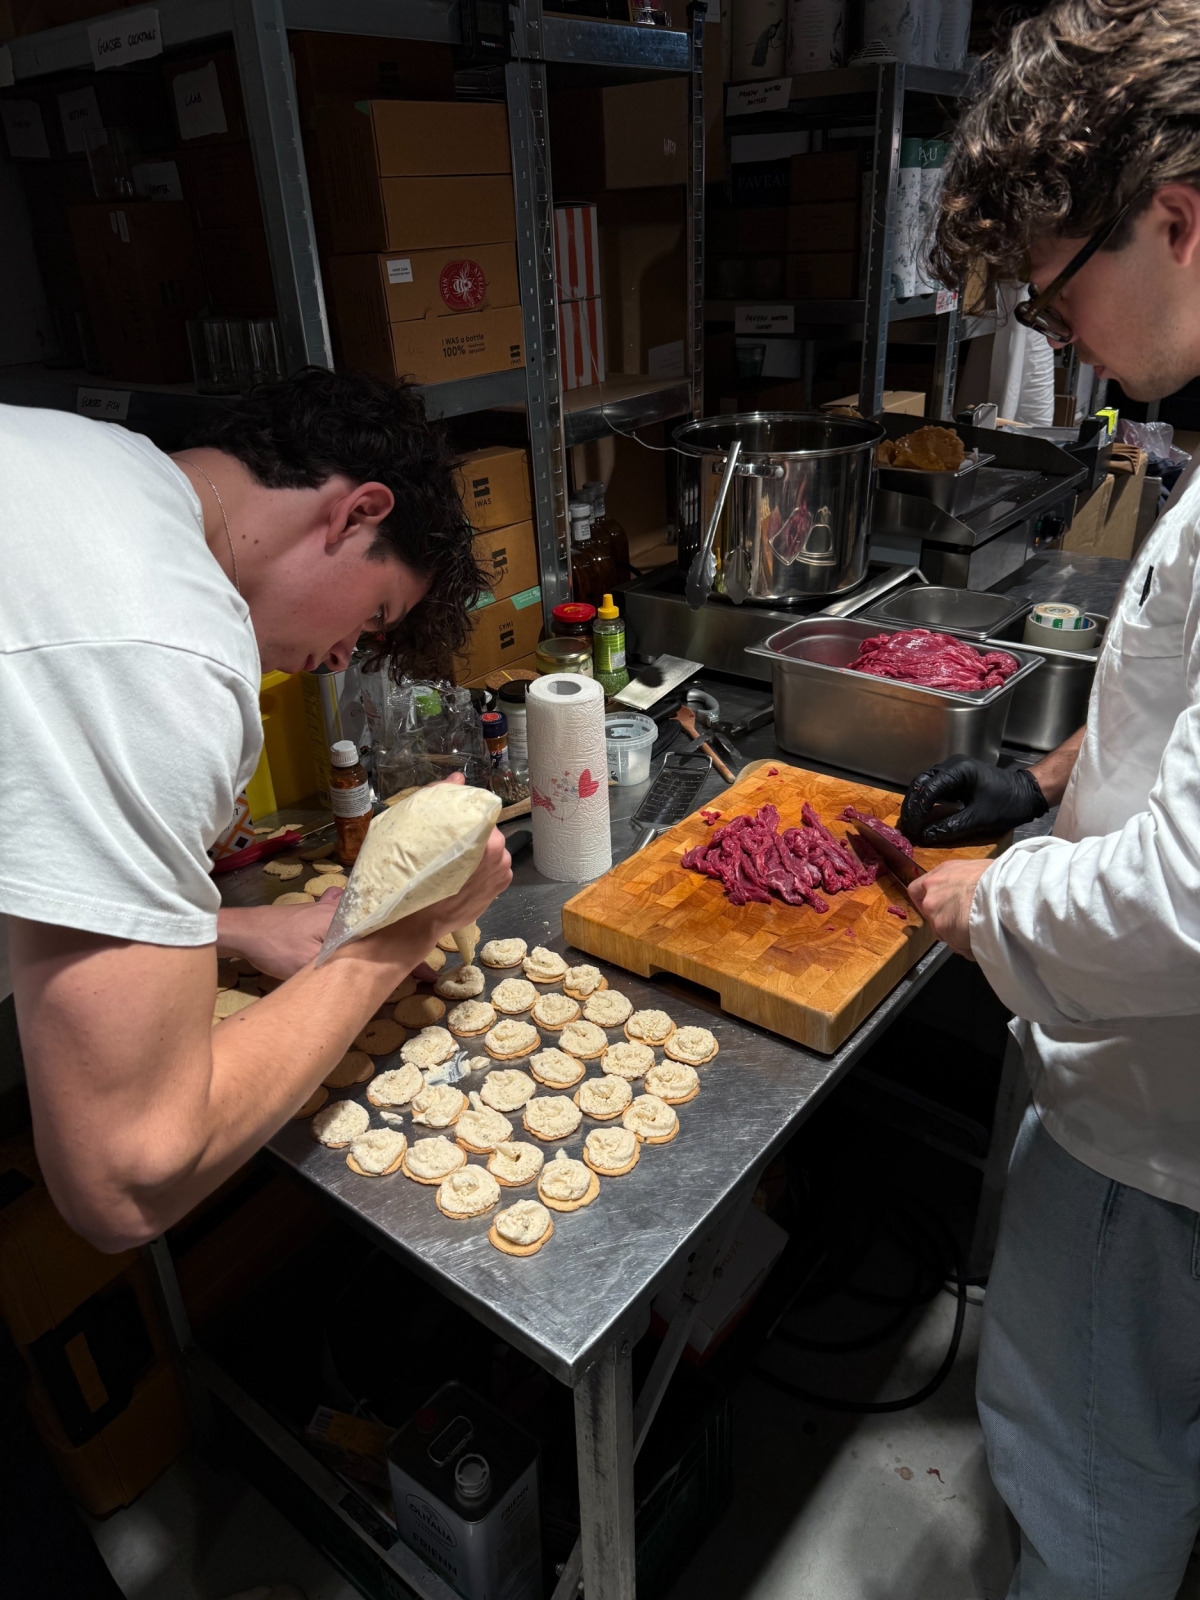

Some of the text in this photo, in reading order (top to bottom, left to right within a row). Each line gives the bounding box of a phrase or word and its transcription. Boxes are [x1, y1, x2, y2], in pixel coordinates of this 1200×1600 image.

[97, 37, 121, 55] GLASSES
[185, 92, 202, 107] CRAB
[445, 336, 459, 345] WAS
[465, 333, 484, 342] bottle
[443, 345, 466, 358] 100%
[474, 498, 492, 508] IWAS
[498, 620, 514, 632] IWAS
[501, 1484, 529, 1521] FRIENN
[409, 1503, 453, 1544] OLITALIA
[412, 1531, 458, 1576] FRIENN
